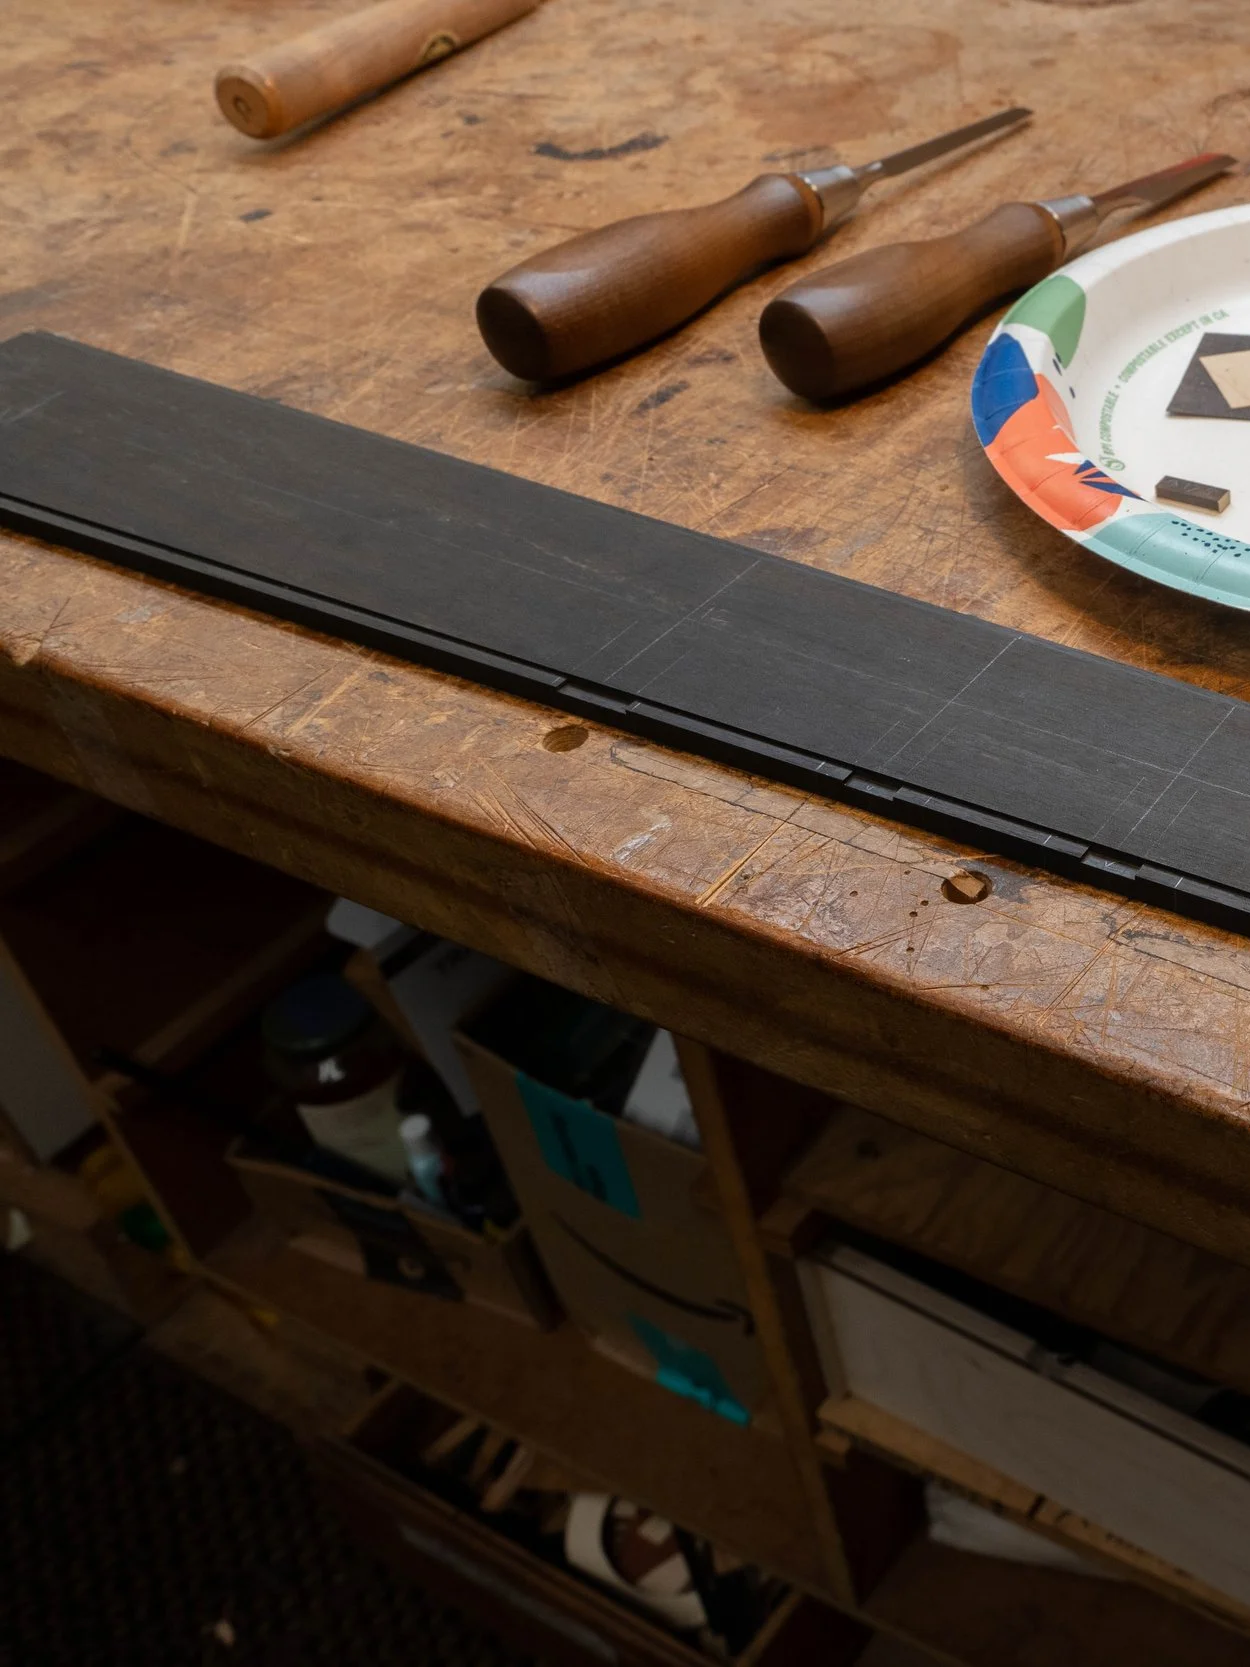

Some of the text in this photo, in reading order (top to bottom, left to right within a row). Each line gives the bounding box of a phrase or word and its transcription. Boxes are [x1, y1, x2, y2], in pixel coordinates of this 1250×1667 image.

[1099, 390, 1119, 442] COMPOSTABLE
[1118, 339, 1168, 383] COMPOSTABLE
[1163, 320, 1199, 344] EXCEPT
[1198, 314, 1213, 326] IN
[1212, 309, 1230, 321] CA
